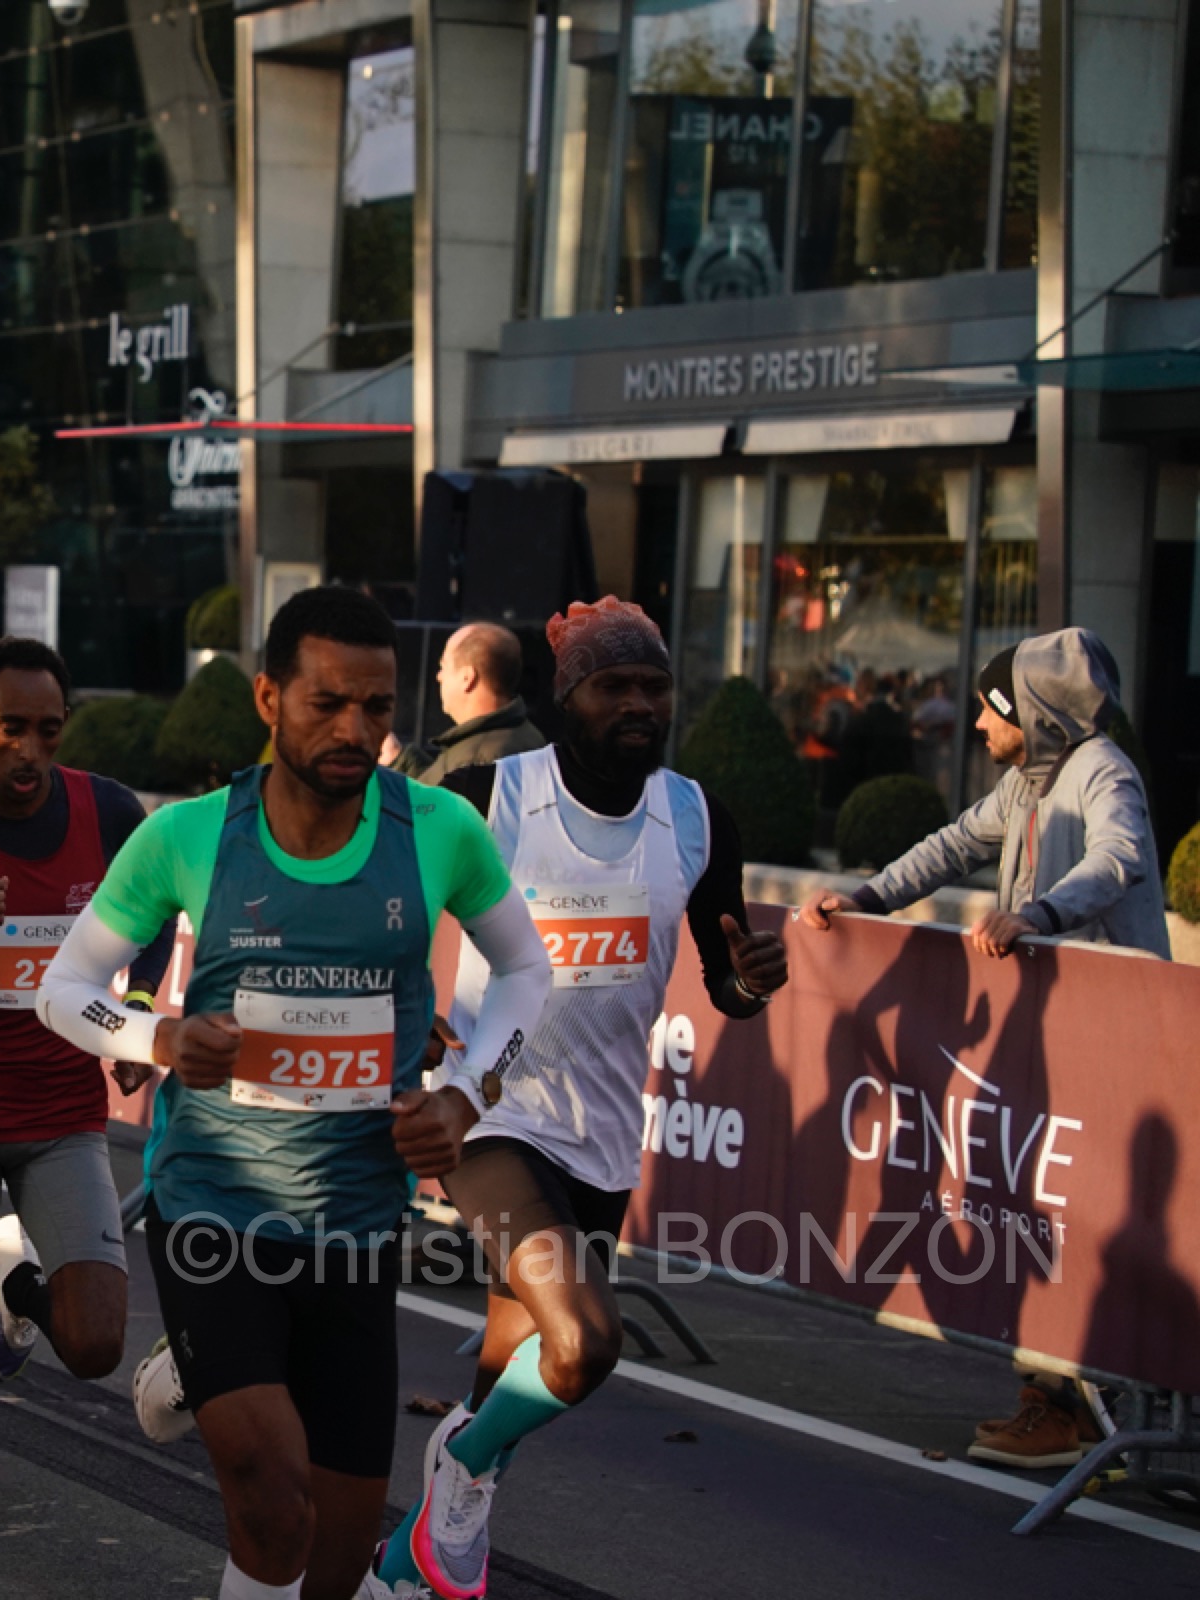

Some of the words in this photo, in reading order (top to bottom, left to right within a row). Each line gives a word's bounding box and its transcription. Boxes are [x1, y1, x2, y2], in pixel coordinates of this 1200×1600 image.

[108, 311, 133, 366] le
[135, 303, 189, 383] grill
[624, 358, 743, 400] MONTRES
[751, 343, 879, 393] PRESTIGE
[229, 935, 282, 948] YUSTER
[543, 930, 637, 964] 2774
[276, 965, 395, 989] GENERALI
[281, 1008, 350, 1025] GENÈVE
[269, 1048, 380, 1086] 2975
[840, 1044, 1083, 1207] GENÈVE
[920, 1190, 1067, 1246] AÉROPORT
